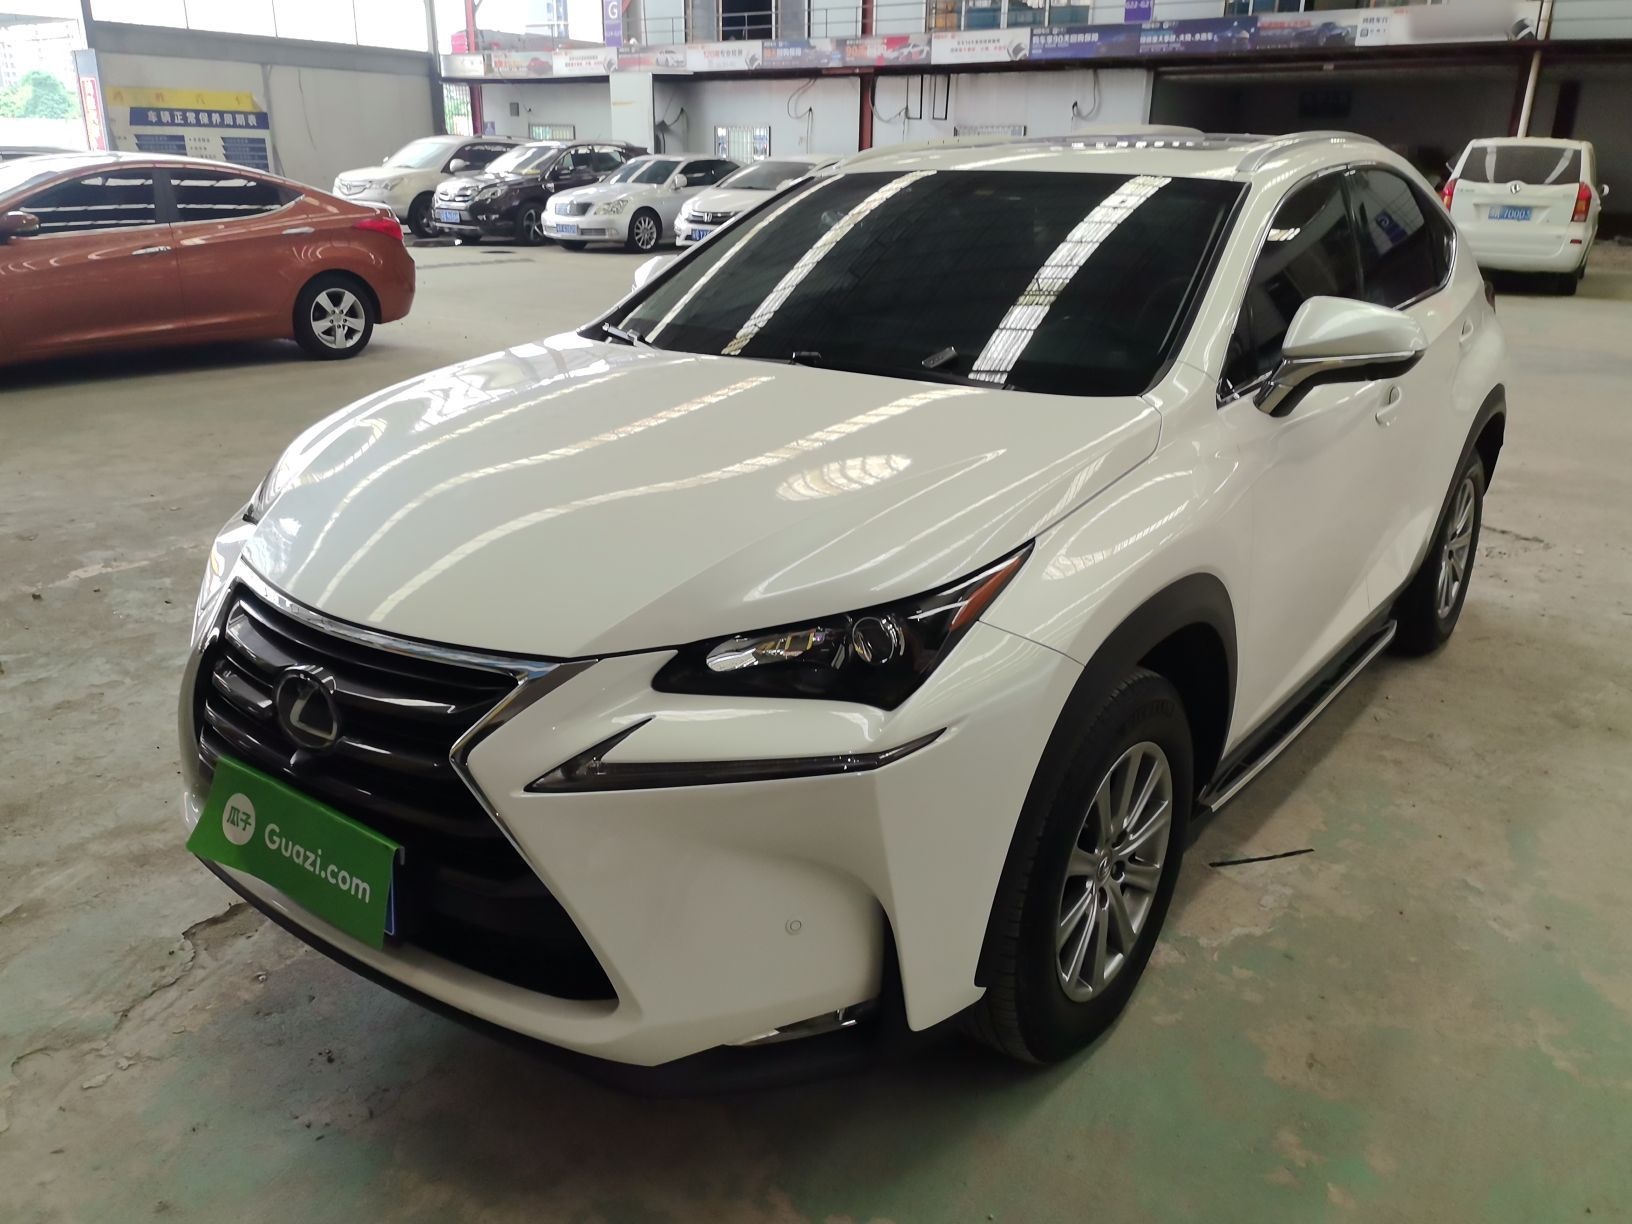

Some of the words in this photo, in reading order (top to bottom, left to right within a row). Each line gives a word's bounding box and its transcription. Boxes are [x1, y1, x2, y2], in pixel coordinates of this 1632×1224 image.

[608, 1, 618, 19] G
[226, 805, 252, 832] 瓜子
[264, 822, 371, 904] Guazi.com
